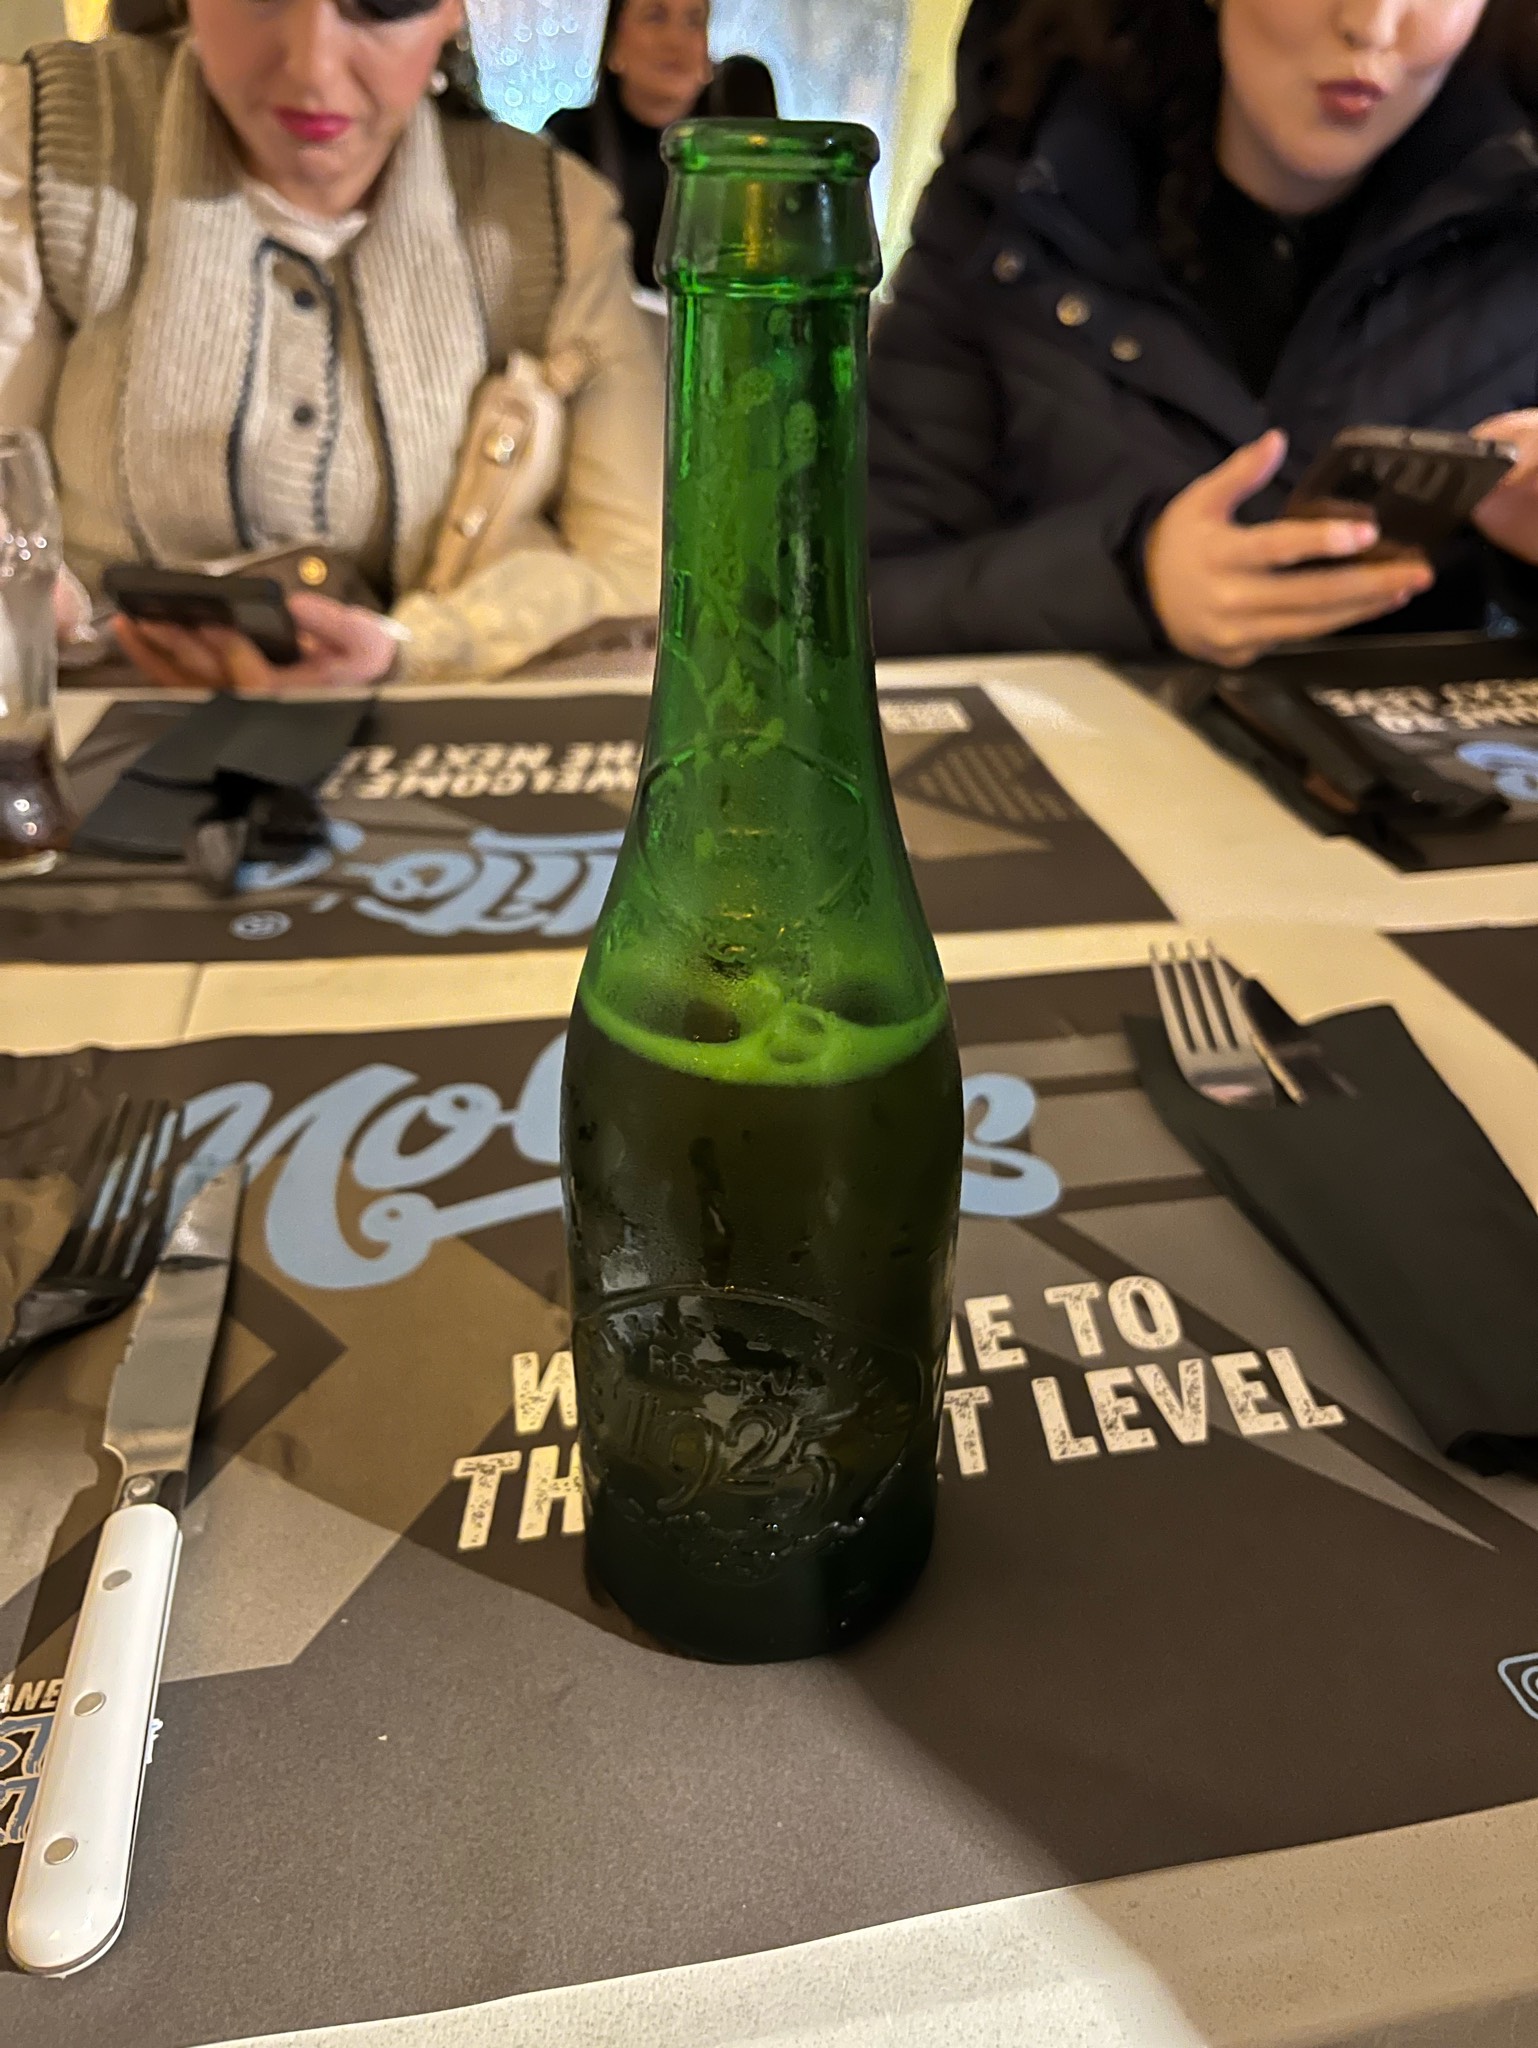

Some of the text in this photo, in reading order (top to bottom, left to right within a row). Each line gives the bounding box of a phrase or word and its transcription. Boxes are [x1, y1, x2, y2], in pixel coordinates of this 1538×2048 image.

[1043, 1274, 1182, 1359] TO
[452, 1443, 586, 1551] TH
[1030, 1346, 1348, 1463] LEVEL
